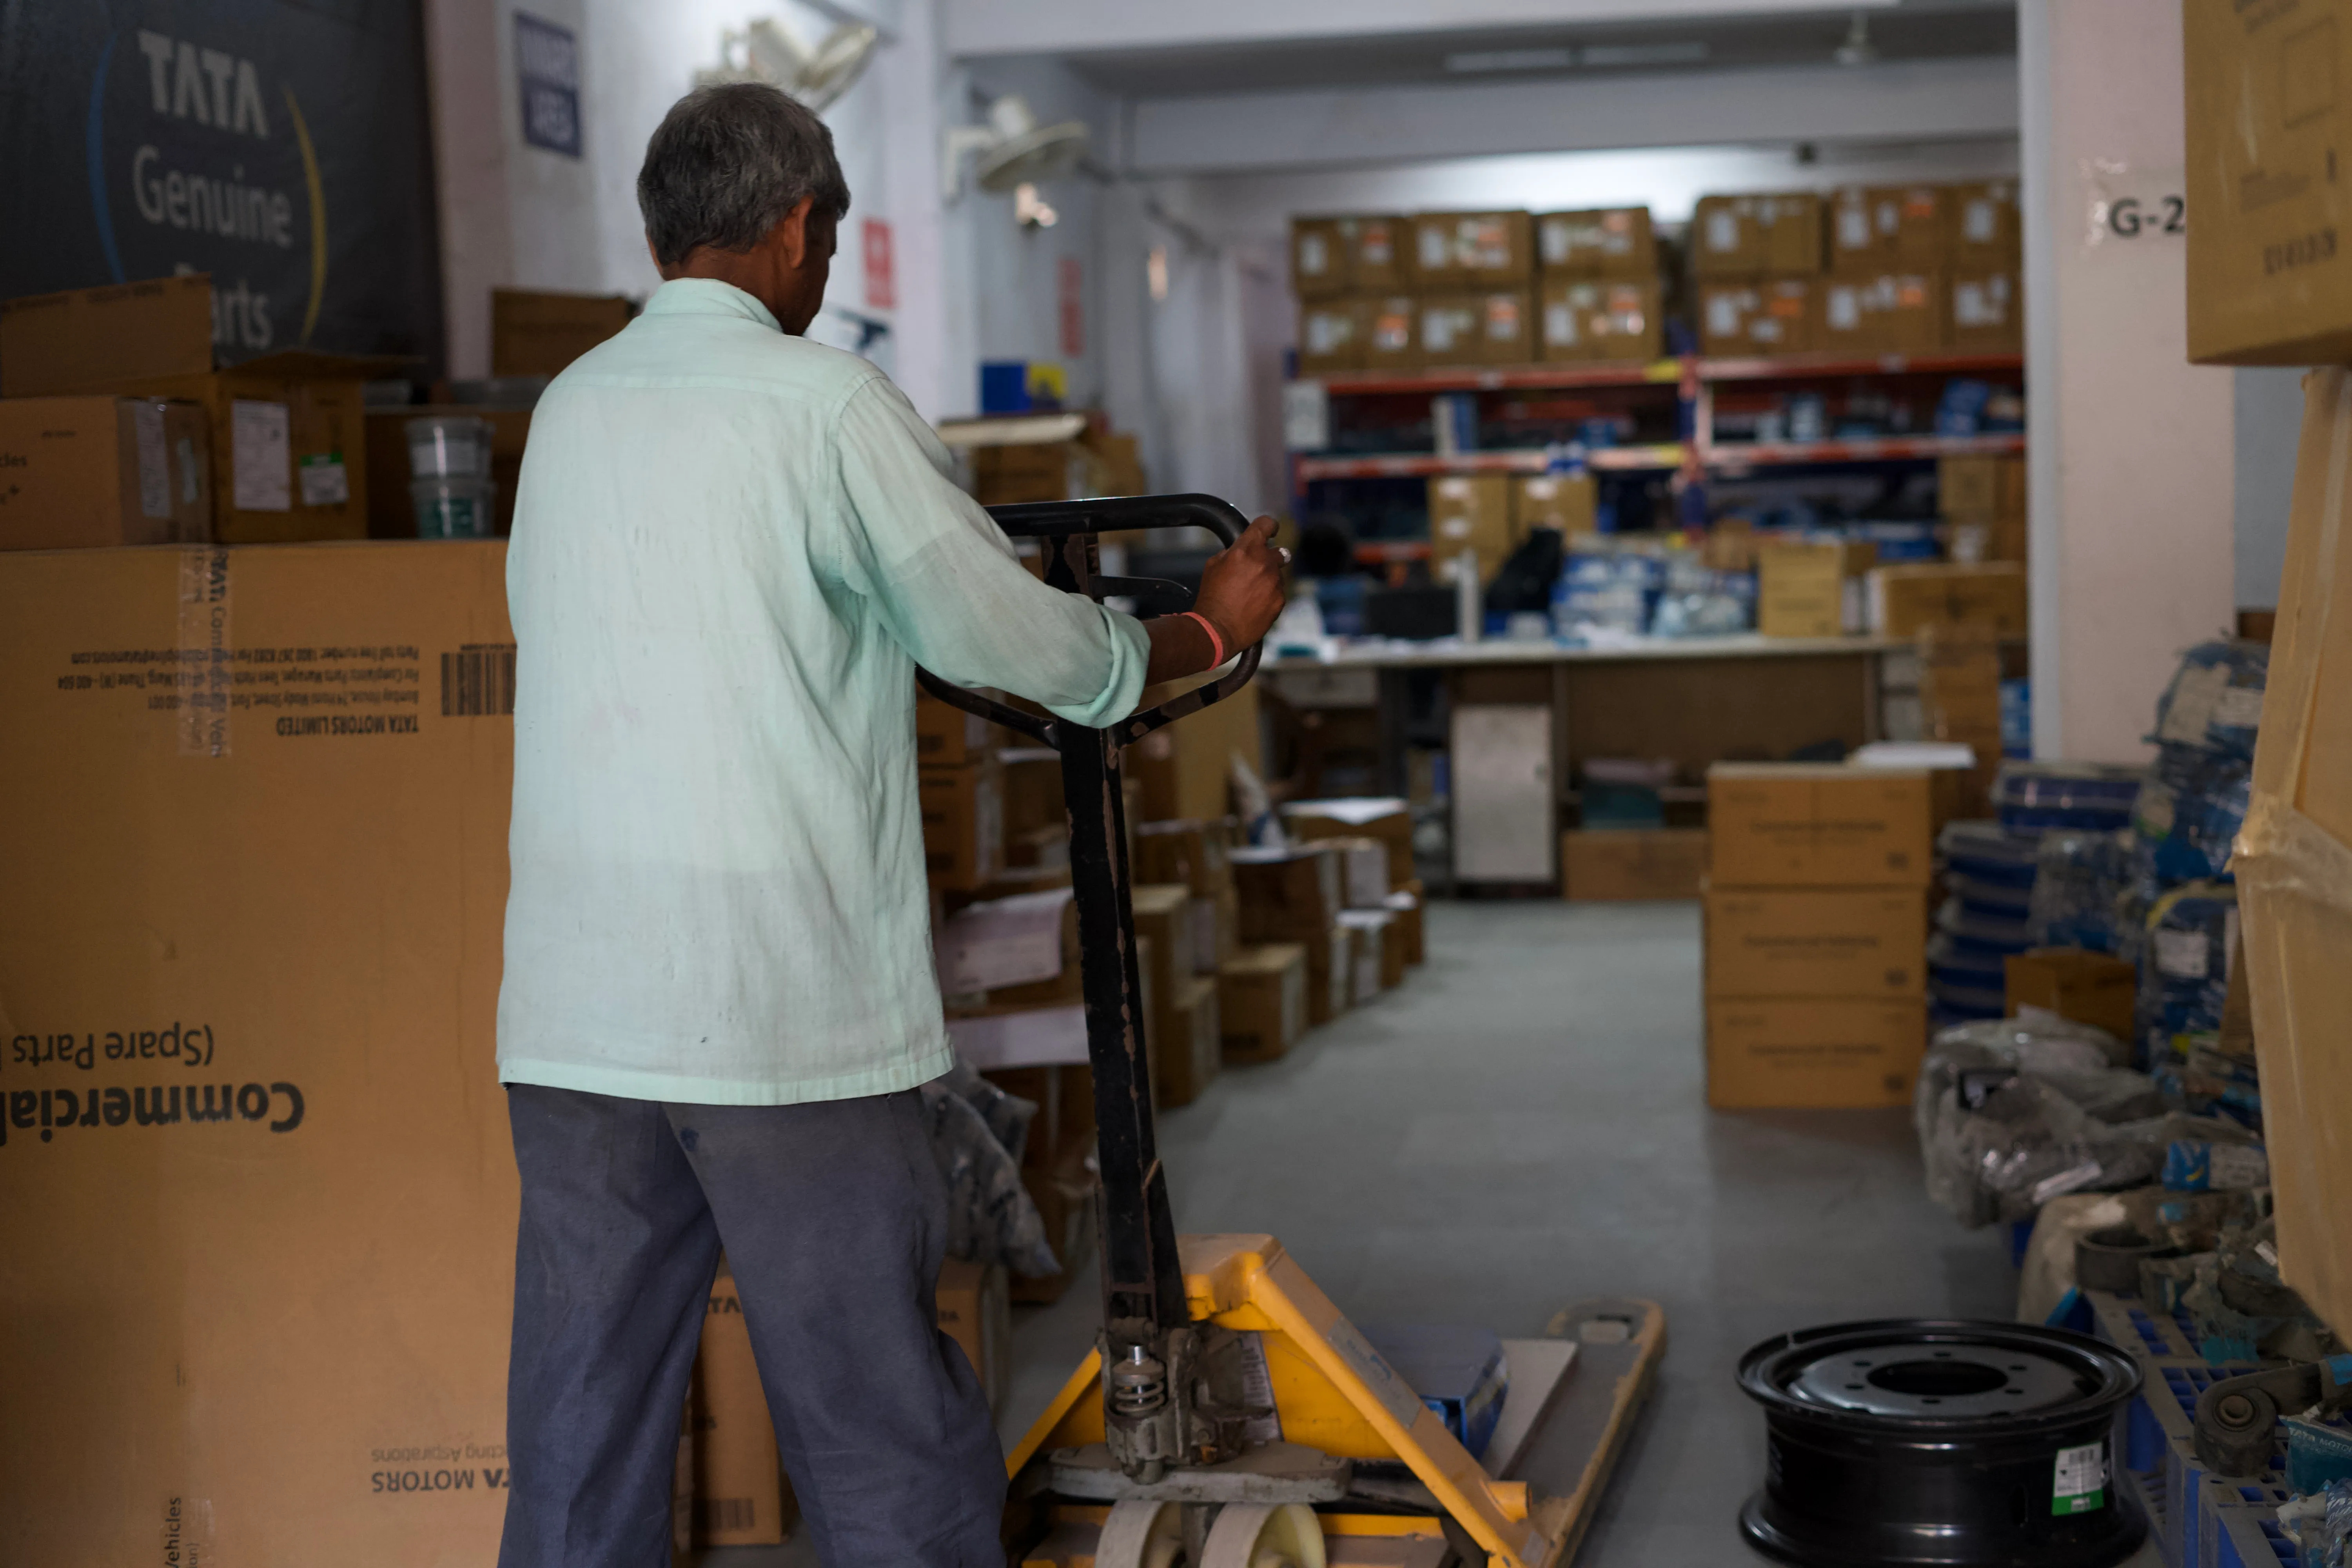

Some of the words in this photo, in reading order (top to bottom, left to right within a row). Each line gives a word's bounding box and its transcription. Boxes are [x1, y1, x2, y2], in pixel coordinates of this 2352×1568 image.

[136, 28, 270, 139] TATA
[132, 144, 293, 249] Genuine
[276, 716, 329, 737] LIMITED
[331, 715, 386, 735] MOTORS
[388, 715, 419, 734] TATA
[12, 1033, 95, 1071] Parts
[104, 1021, 215, 1069] (Spare
[709, 1296, 742, 1314] TA
[370, 1444, 463, 1464] Aspirations
[466, 1443, 506, 1461] cting
[370, 1469, 474, 1494] MOTORS
